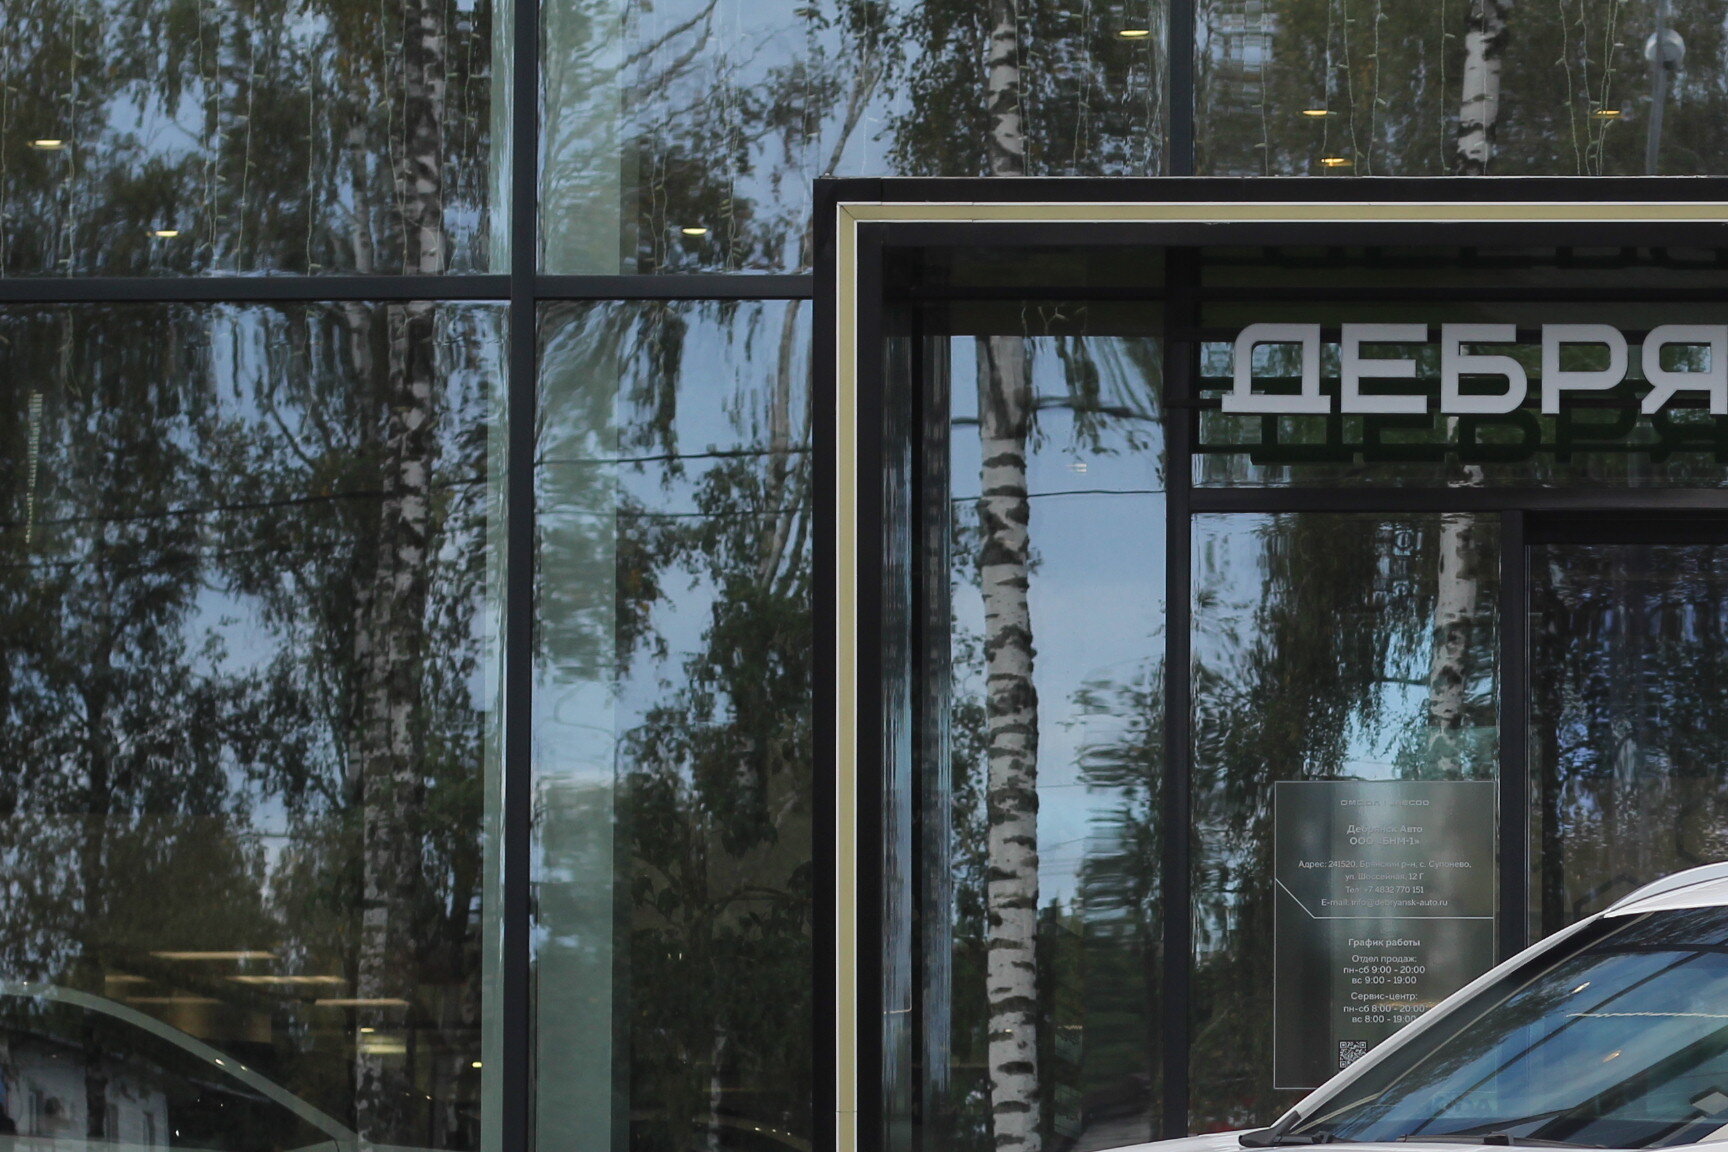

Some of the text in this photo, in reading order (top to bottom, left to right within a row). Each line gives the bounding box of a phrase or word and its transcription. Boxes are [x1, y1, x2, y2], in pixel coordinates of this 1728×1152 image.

[1400, 824, 1423, 833] Авто
[1349, 836, 1374, 845] ООО
[1298, 860, 1327, 870] Адрес:
[1375, 886, 1395, 894] 4832
[1396, 886, 1411, 894] 770
[1412, 886, 1424, 894] 151
[1348, 938, 1421, 948] График работы
[1351, 955, 1417, 964] Отдел продаж:
[1343, 965, 1370, 974] пн-сб
[1371, 966, 1392, 974] 9:00
[1399, 966, 1426, 974] 20:00
[1351, 977, 1363, 985] вс
[1364, 976, 1385, 984] 9:00
[1393, 976, 1417, 984] 19:00
[1350, 992, 1418, 1001] Сервис-центр:
[1343, 1005, 1370, 1013] пн-сб
[1371, 1005, 1392, 1013] 8:00
[1399, 1005, 1425, 1013] 20:00
[1364, 1015, 1385, 1023] 8:00
